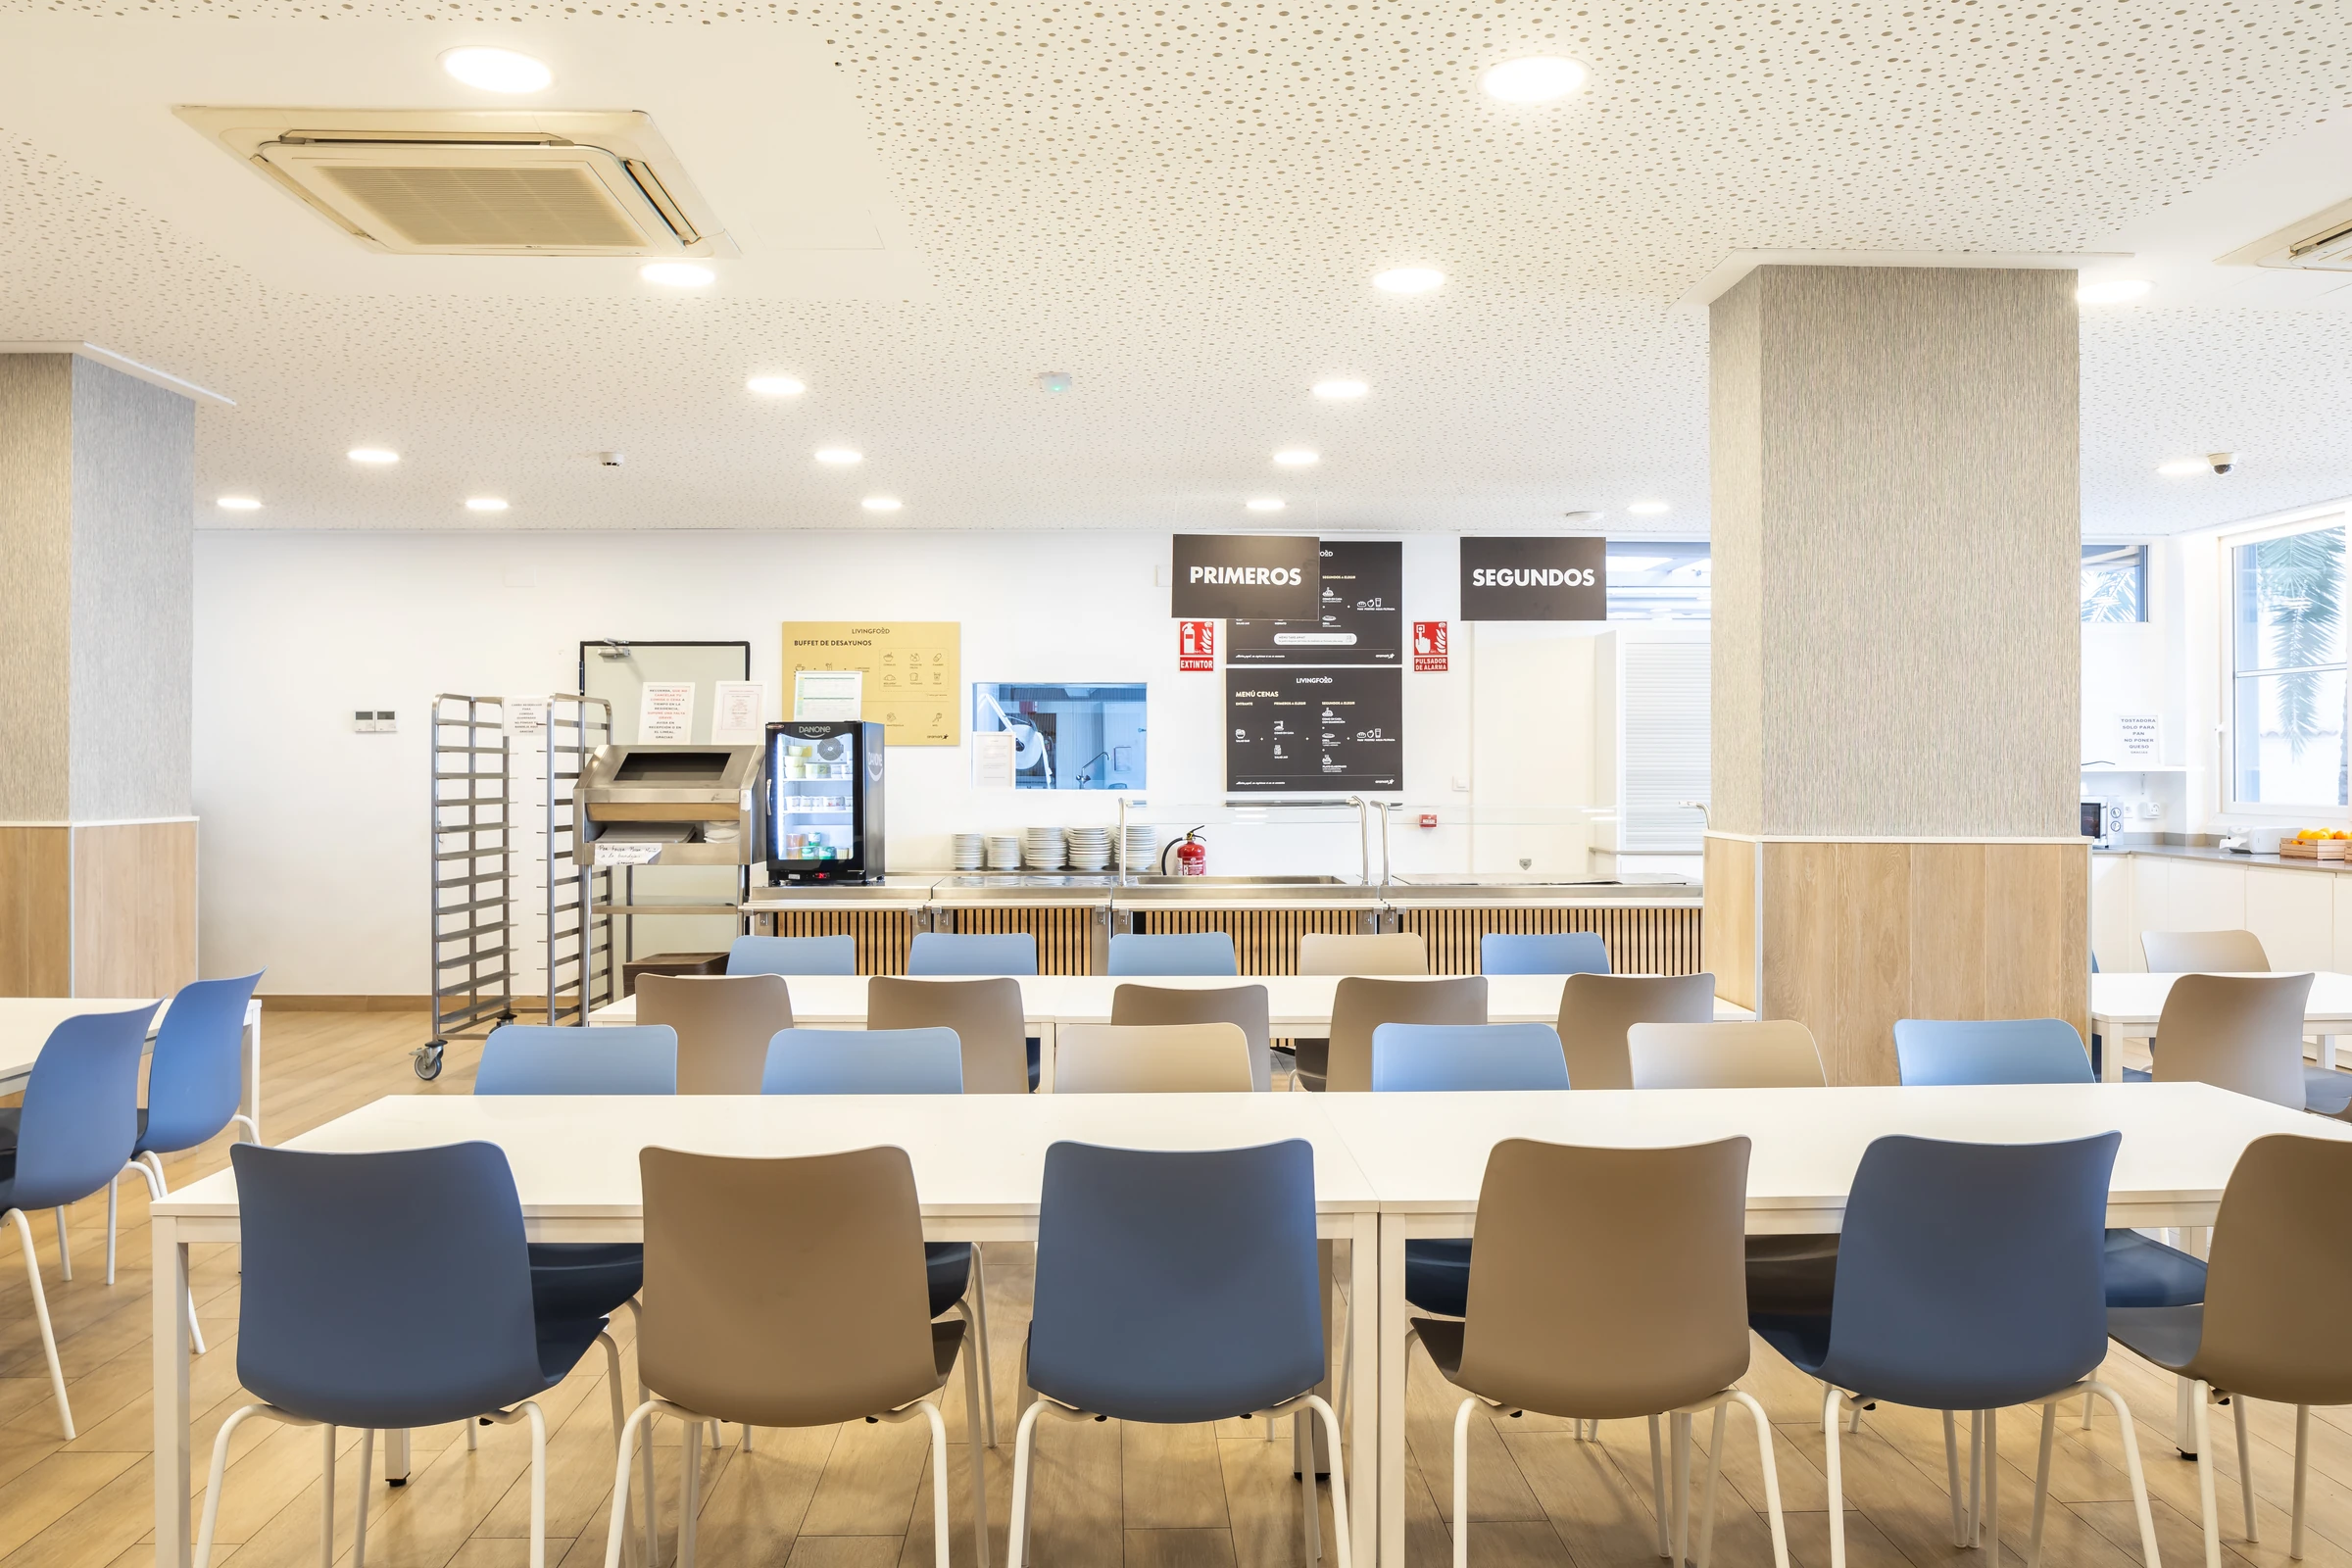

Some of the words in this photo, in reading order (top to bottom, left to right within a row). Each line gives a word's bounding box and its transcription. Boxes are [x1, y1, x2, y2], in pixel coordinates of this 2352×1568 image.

[1189, 566, 1302, 586] PRIMEROS
[1473, 568, 1595, 587] SEGUNDOS
[1180, 660, 1213, 669] EXTINTOR
